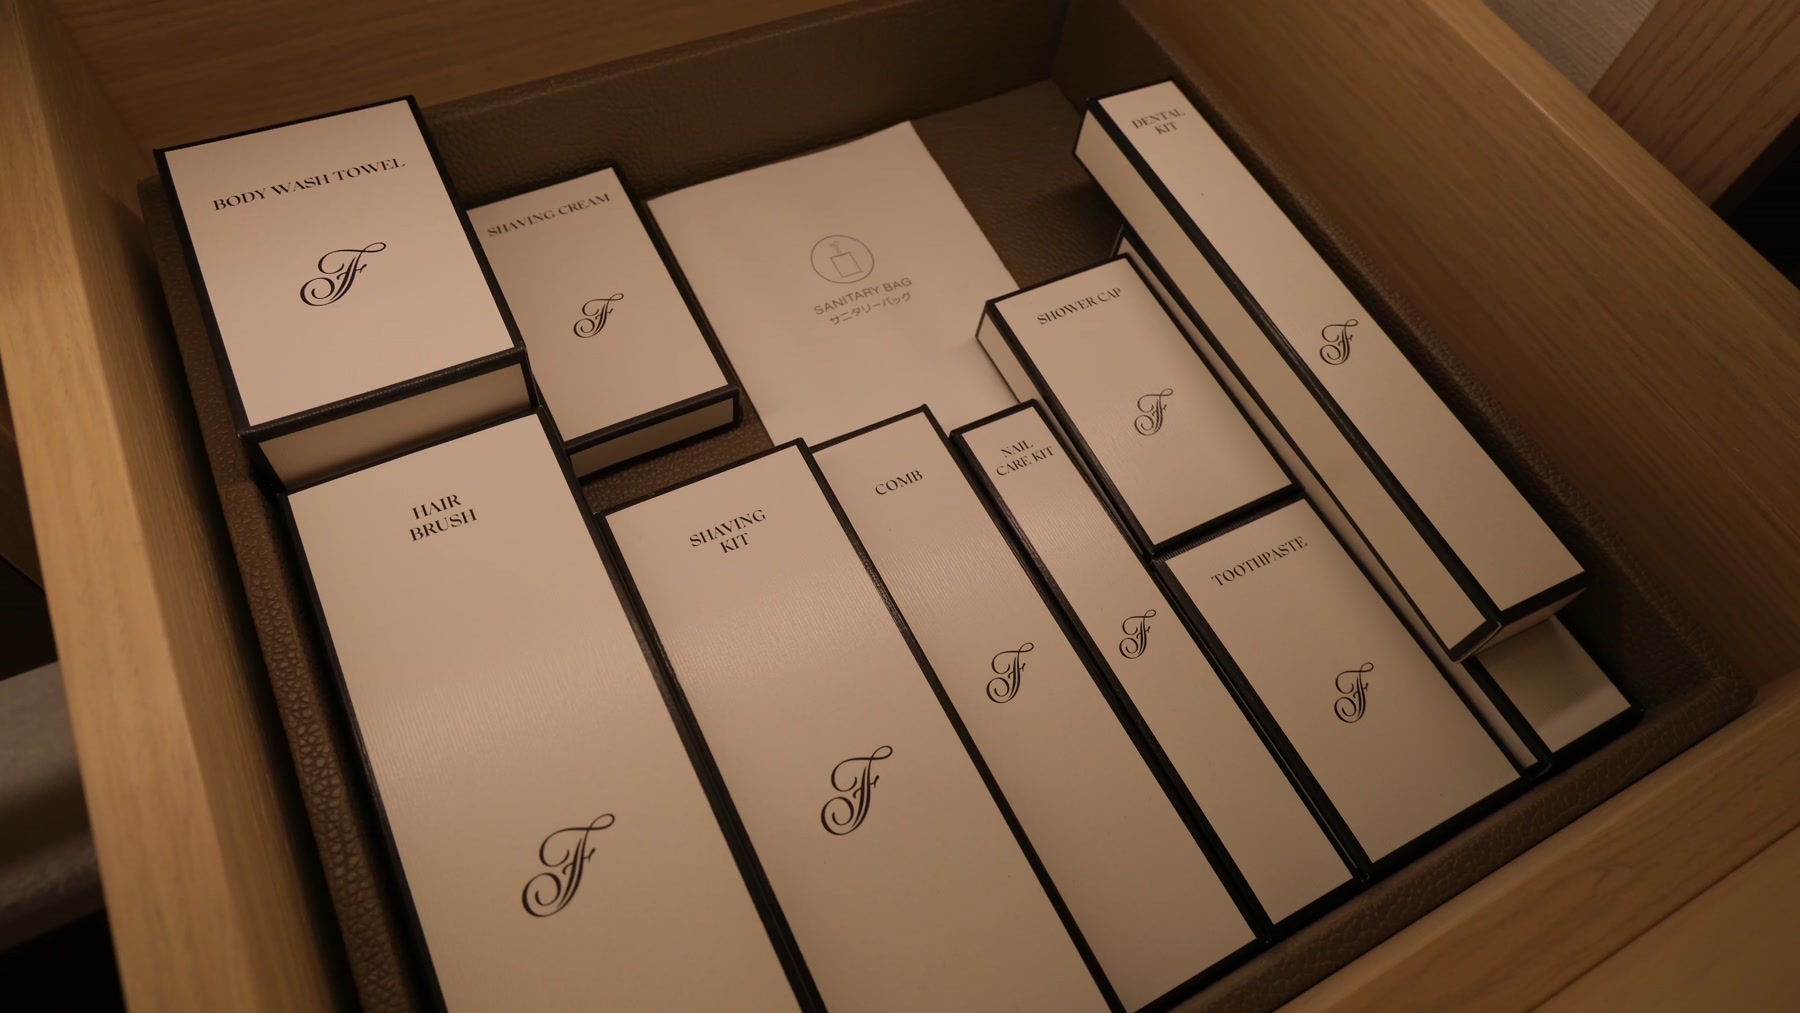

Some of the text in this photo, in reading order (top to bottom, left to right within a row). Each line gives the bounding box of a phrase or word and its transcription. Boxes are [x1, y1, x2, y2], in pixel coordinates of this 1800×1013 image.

[1132, 109, 1185, 129] DENTAL
[1155, 121, 1177, 135] KIT
[213, 158, 406, 211] BODY WASH TOWEL
[487, 193, 611, 238] SHAVING CREAM
[813, 277, 913, 315] SANITARY BAG
[1037, 287, 1121, 325] SHOWER CAP
[996, 446, 1054, 476] CARE KIT
[1001, 440, 1033, 458] NAIL
[875, 469, 923, 496] COMB
[412, 494, 462, 520] HAIR
[409, 507, 477, 542] BRUSH
[689, 509, 766, 547] SHAVING
[720, 532, 749, 554] KIT
[1211, 536, 1308, 587] TOOTHPASTE
